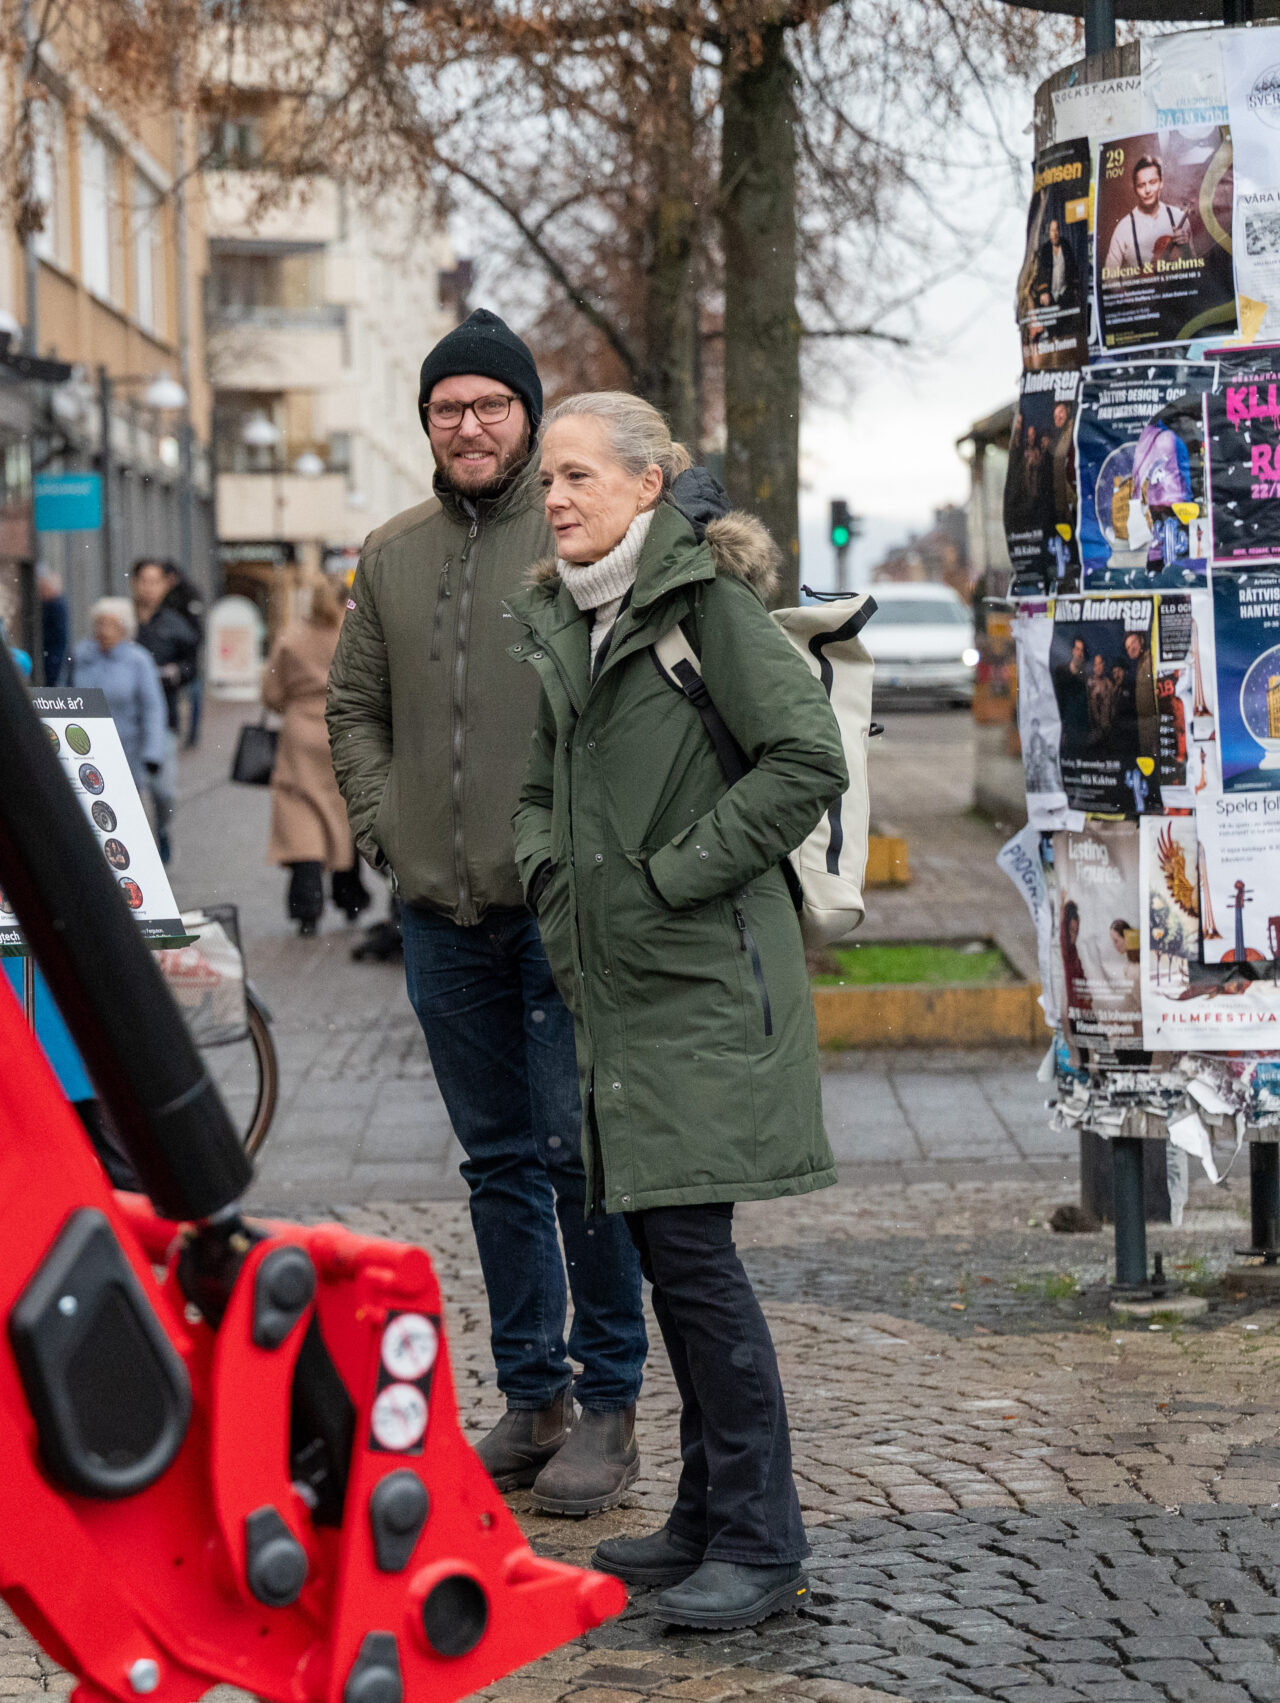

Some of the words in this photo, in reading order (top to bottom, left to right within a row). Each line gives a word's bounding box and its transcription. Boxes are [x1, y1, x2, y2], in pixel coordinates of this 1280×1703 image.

[1106, 149, 1124, 168] 29
[1106, 167, 1124, 179] nov
[1143, 262, 1154, 275] &
[1157, 258, 1205, 273] Brahms
[1082, 599, 1152, 622] Andersen
[67, 697, 84, 710] är?
[1216, 797, 1258, 816] Spela
